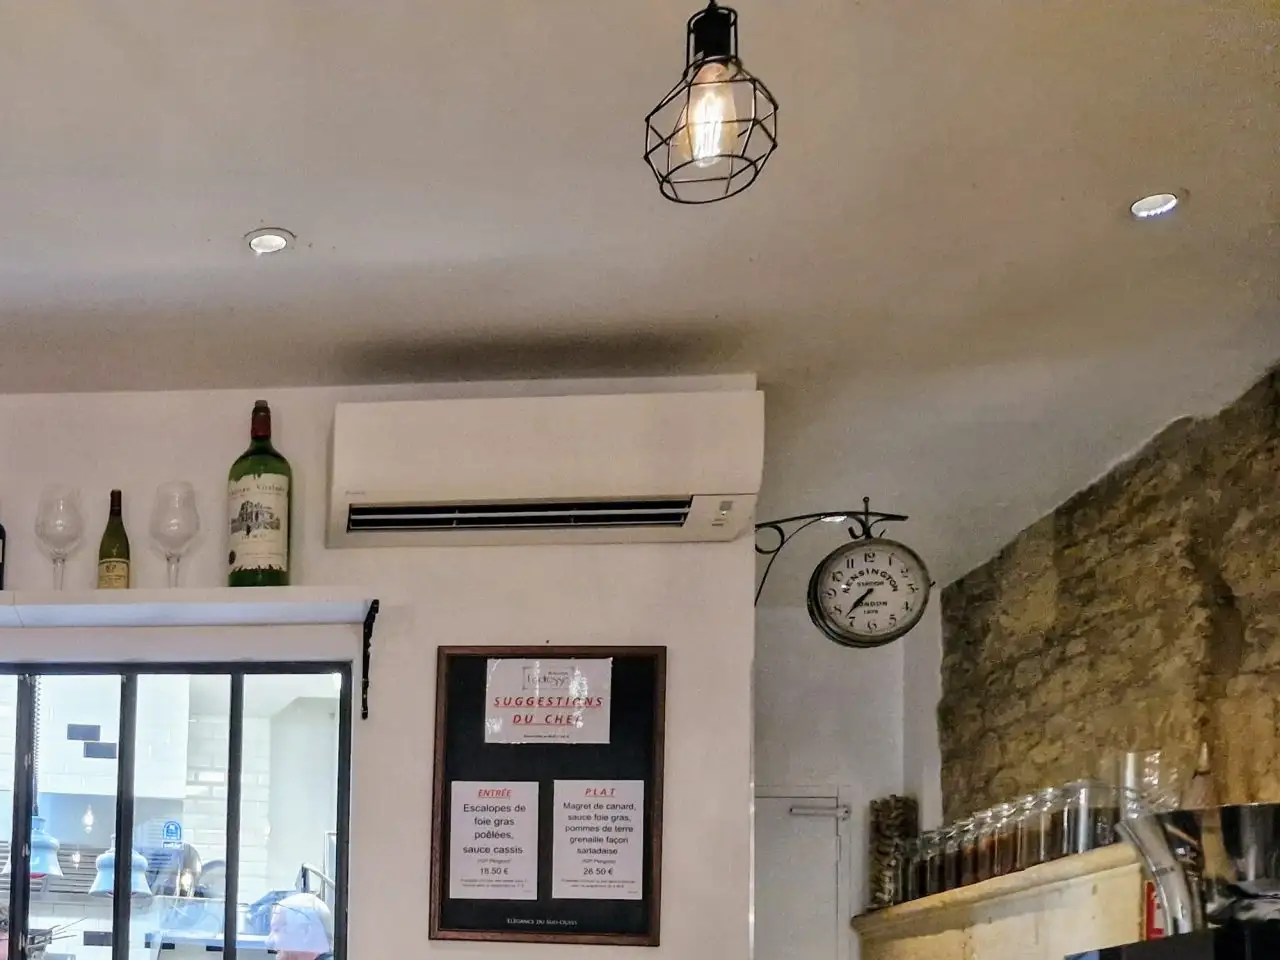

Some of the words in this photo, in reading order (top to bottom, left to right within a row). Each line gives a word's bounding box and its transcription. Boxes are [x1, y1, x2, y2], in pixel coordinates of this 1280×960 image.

[864, 552, 875, 562] 12
[846, 558, 854, 568] 11
[842, 567, 899, 594] KENSINGTON
[494, 696, 604, 707] SUGGESTIONS
[512, 714, 534, 724] DU
[478, 788, 512, 797] ENTRÉE
[585, 787, 616, 796] PLAT
[463, 803, 512, 814] Escalopes
[514, 803, 526, 813] de
[563, 802, 592, 811] Magret
[593, 802, 604, 810] de
[606, 803, 637, 811] canard,
[474, 816, 492, 826] foie
[493, 818, 515, 827] gras
[594, 813, 609, 821] foie
[565, 825, 600, 833] pommes
[602, 825, 612, 833] de
[614, 825, 634, 833] terre
[569, 836, 604, 845] grenaille
[606, 836, 629, 845] façon
[462, 845, 491, 854] sauce
[493, 845, 524, 854] cassis
